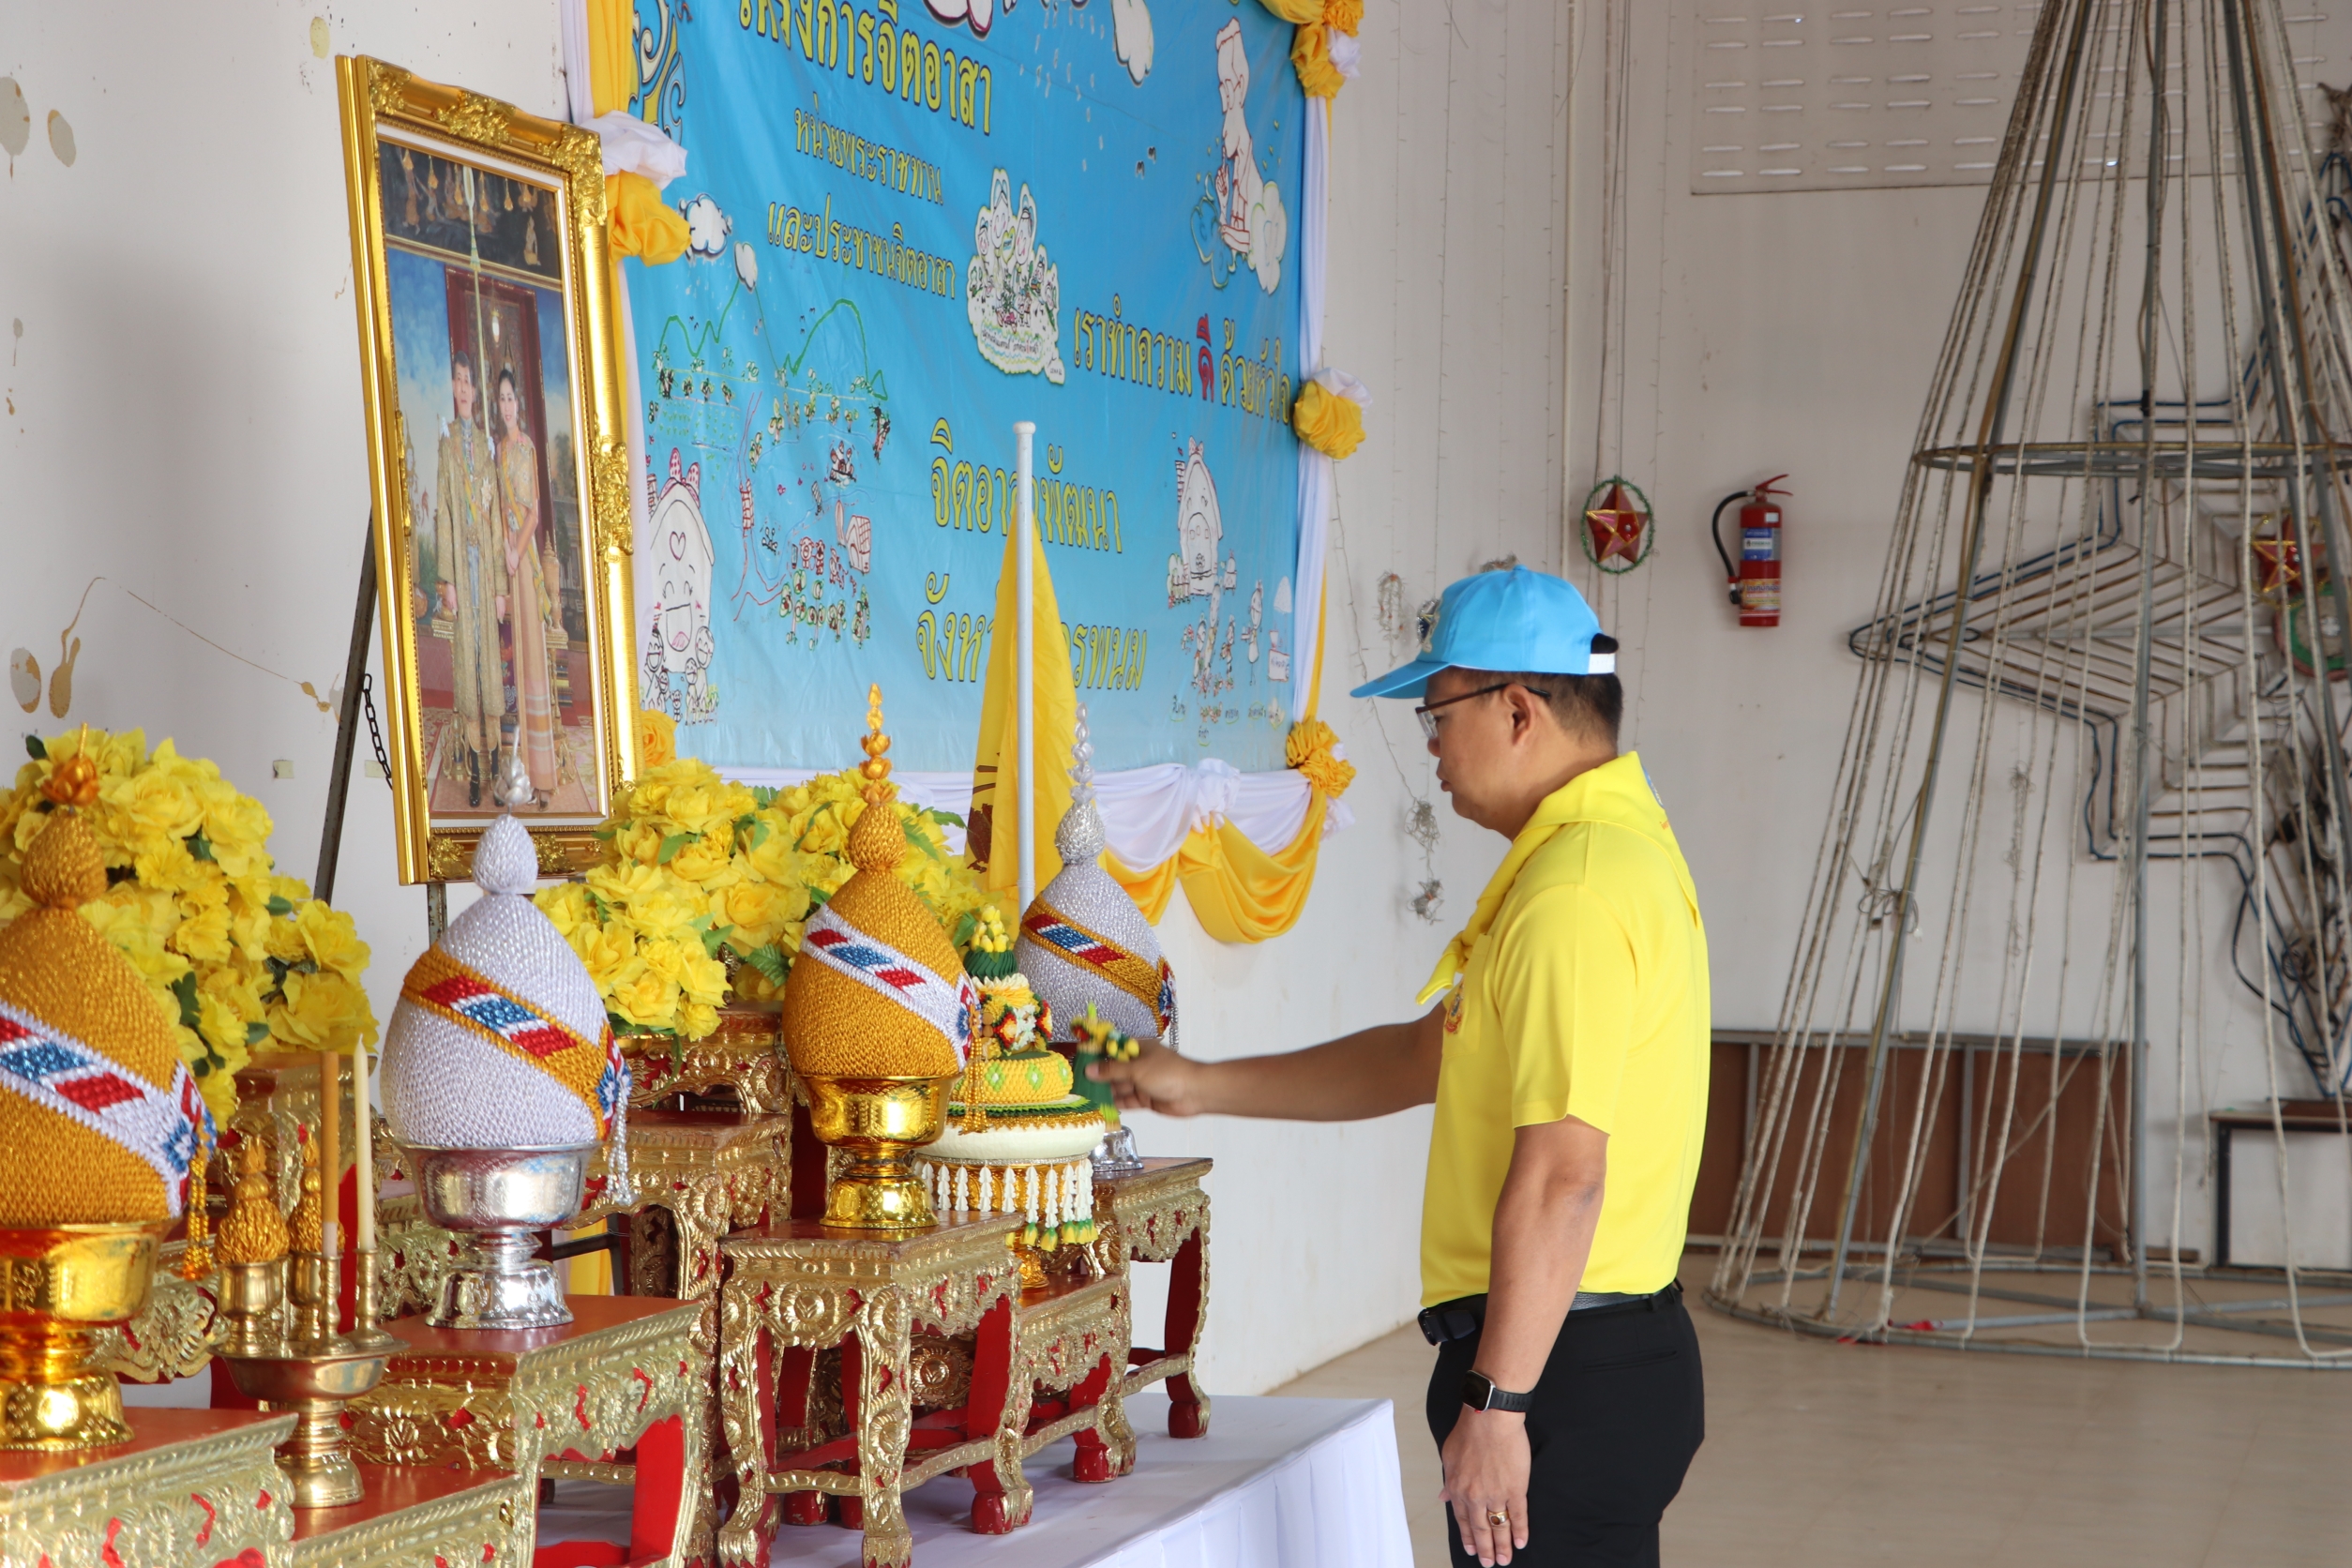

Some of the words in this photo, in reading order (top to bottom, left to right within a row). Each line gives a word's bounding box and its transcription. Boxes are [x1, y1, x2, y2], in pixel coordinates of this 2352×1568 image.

[794, 91, 944, 205] หน่วยพระราชทาน
[768, 192, 956, 299] และประชาชนจิตอาสา
[1074, 293, 1193, 398] เราทำความ
[1197, 312, 1214, 402] ดี
[1220, 317, 1291, 422] ด้วยหัวใจ
